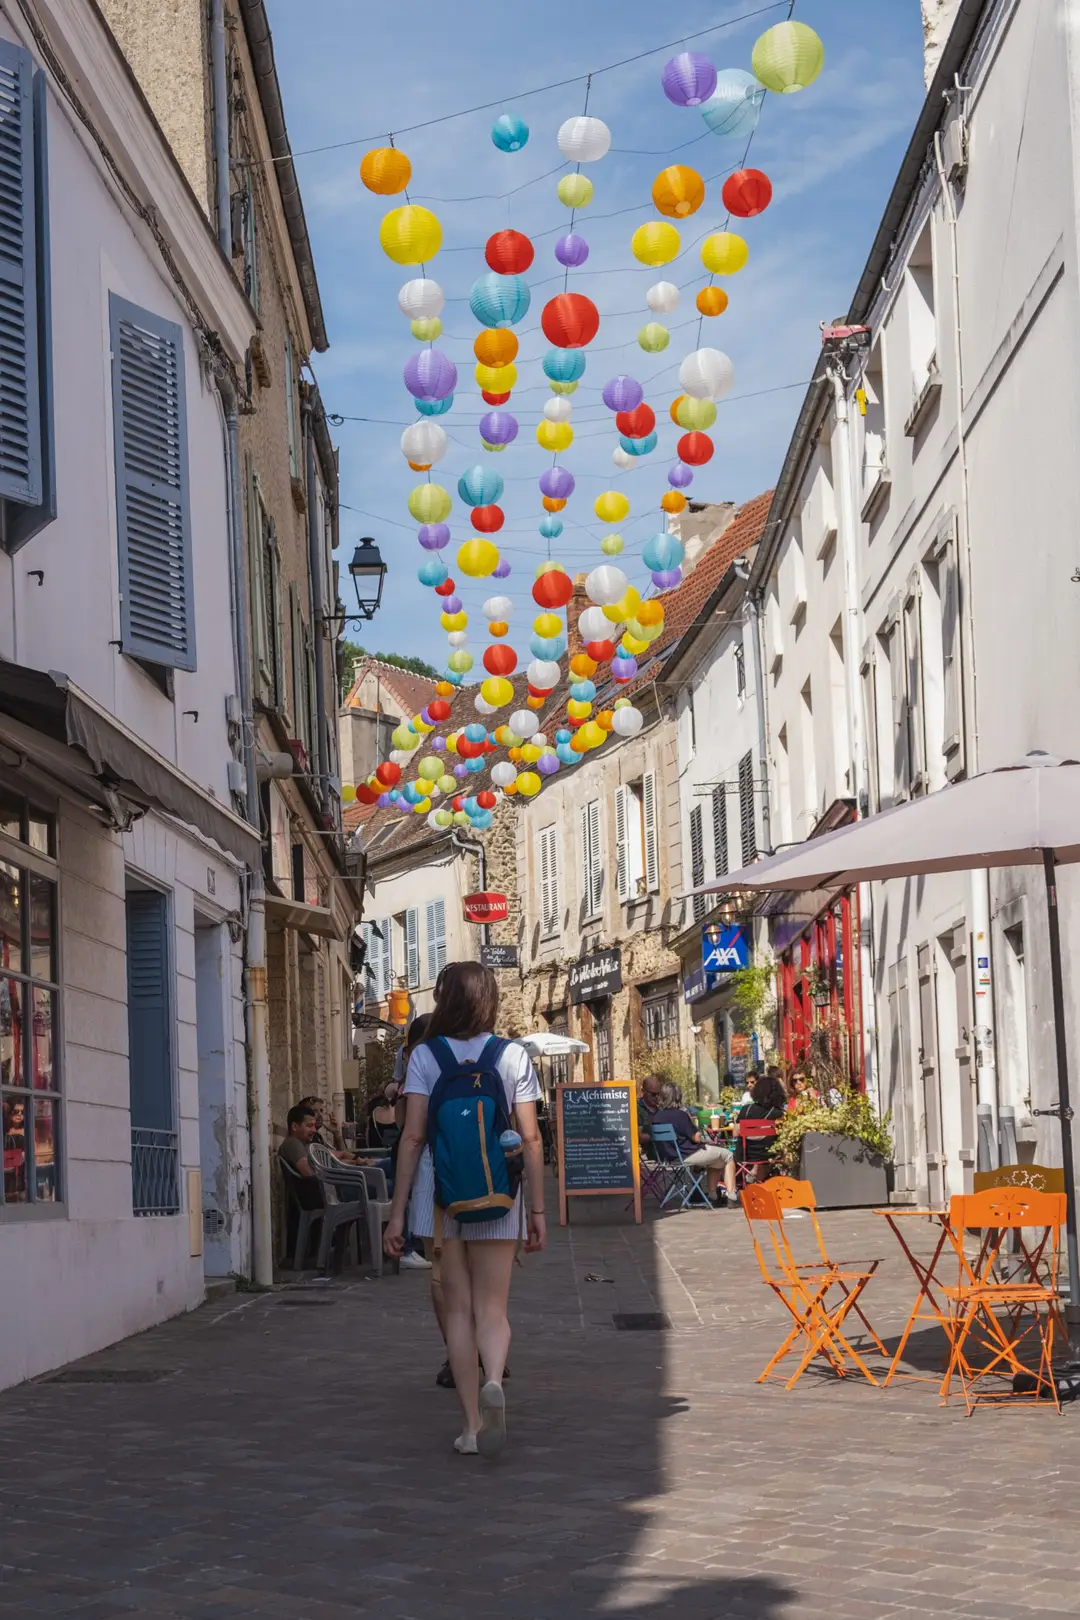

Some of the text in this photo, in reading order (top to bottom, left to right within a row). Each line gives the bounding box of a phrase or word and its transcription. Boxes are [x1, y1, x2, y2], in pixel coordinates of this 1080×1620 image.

[465, 902, 506, 912] RESTAURANT
[704, 947, 742, 966] AXA
[563, 1089, 628, 1104] L'Alchimiste
